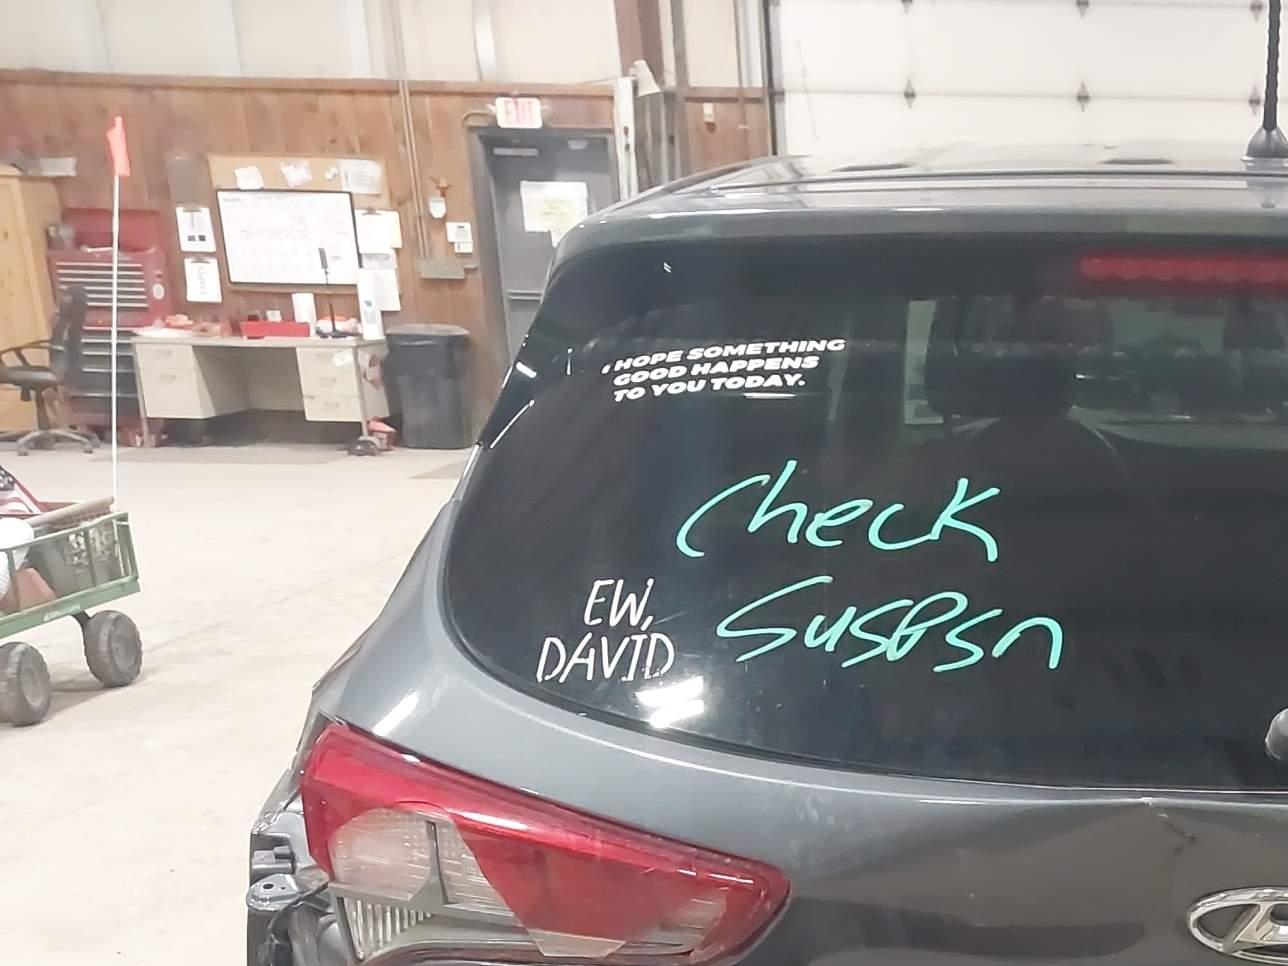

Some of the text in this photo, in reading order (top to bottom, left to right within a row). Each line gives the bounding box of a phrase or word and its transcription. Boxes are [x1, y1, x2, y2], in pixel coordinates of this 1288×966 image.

[613, 350, 685, 371] HOPE
[686, 338, 848, 361] SOMETHING
[613, 355, 820, 386] GOOD HAPPENS
[613, 373, 807, 402] TO YOU TODAY.
[583, 578, 655, 632] EW,
[536, 632, 676, 683] DAVID
